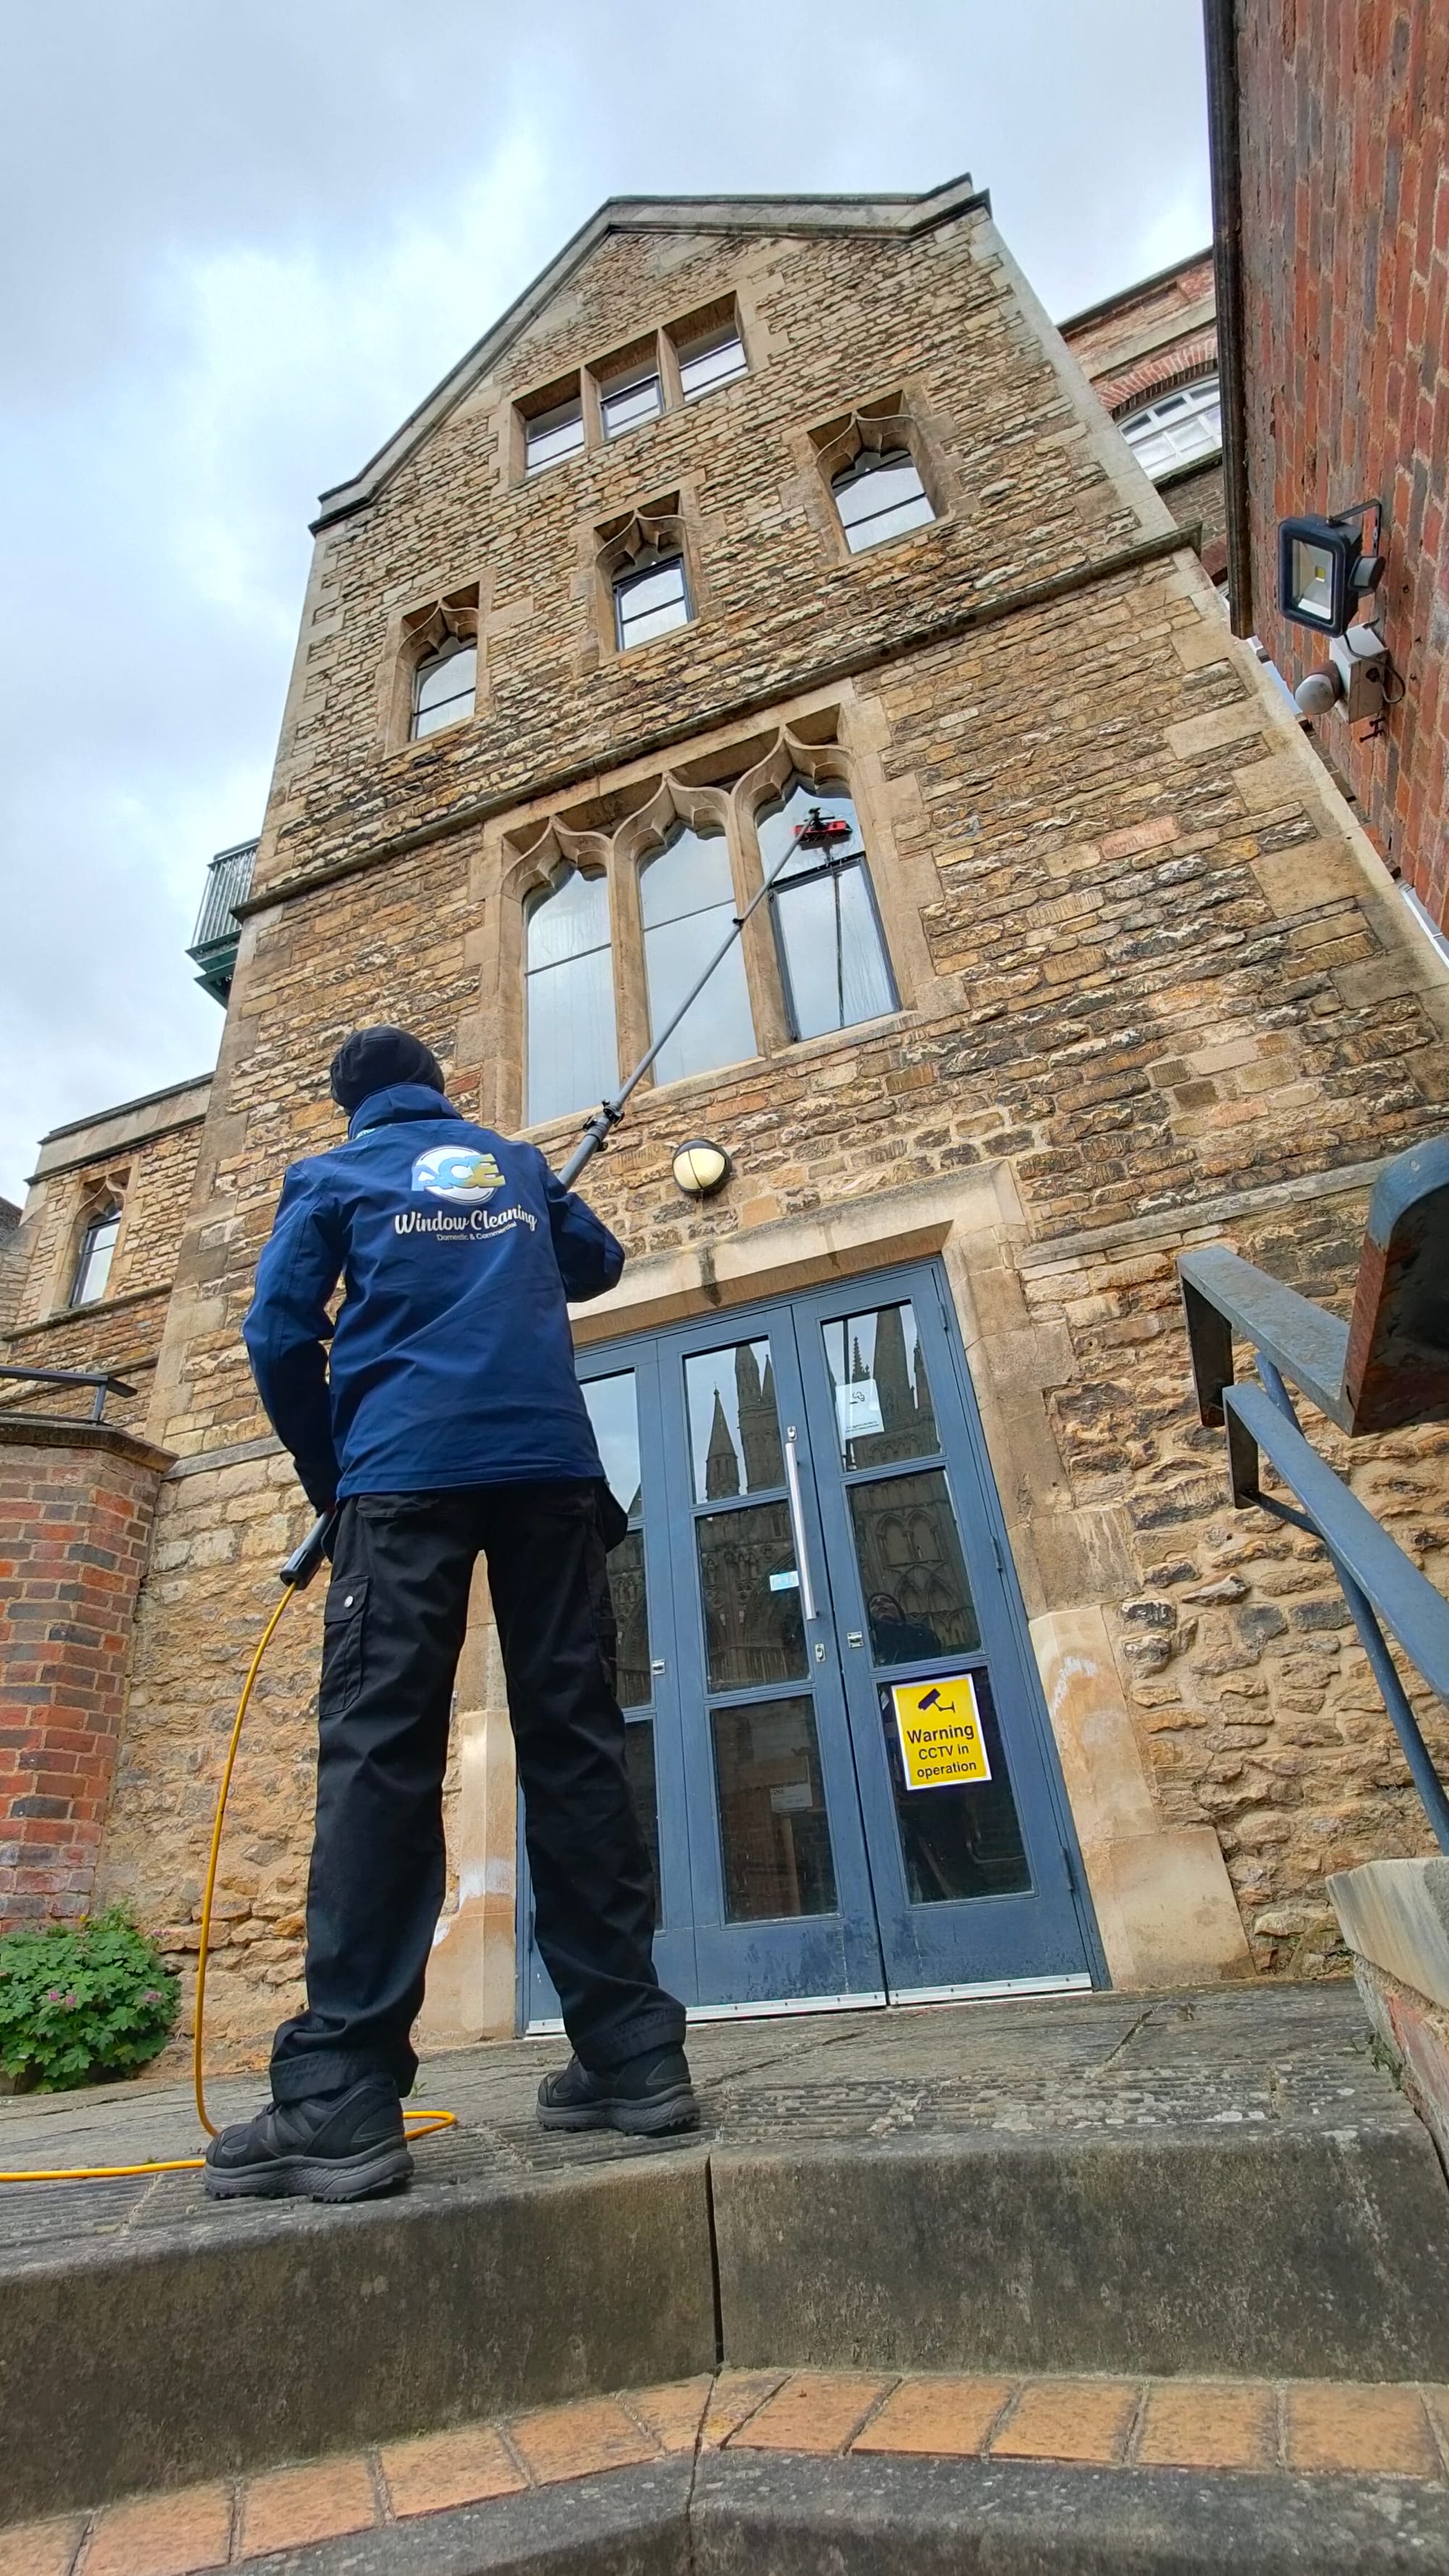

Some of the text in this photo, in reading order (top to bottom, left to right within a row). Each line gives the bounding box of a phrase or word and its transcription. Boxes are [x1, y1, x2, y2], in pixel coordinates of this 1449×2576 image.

[412, 1153, 506, 1191] ACE
[394, 1204, 538, 1234] Window Cleaning
[476, 1221, 517, 1239] Commercial
[907, 1725, 974, 1744] Warning
[919, 1744, 969, 1760] CCTV in
[917, 1761, 977, 1779] operation
